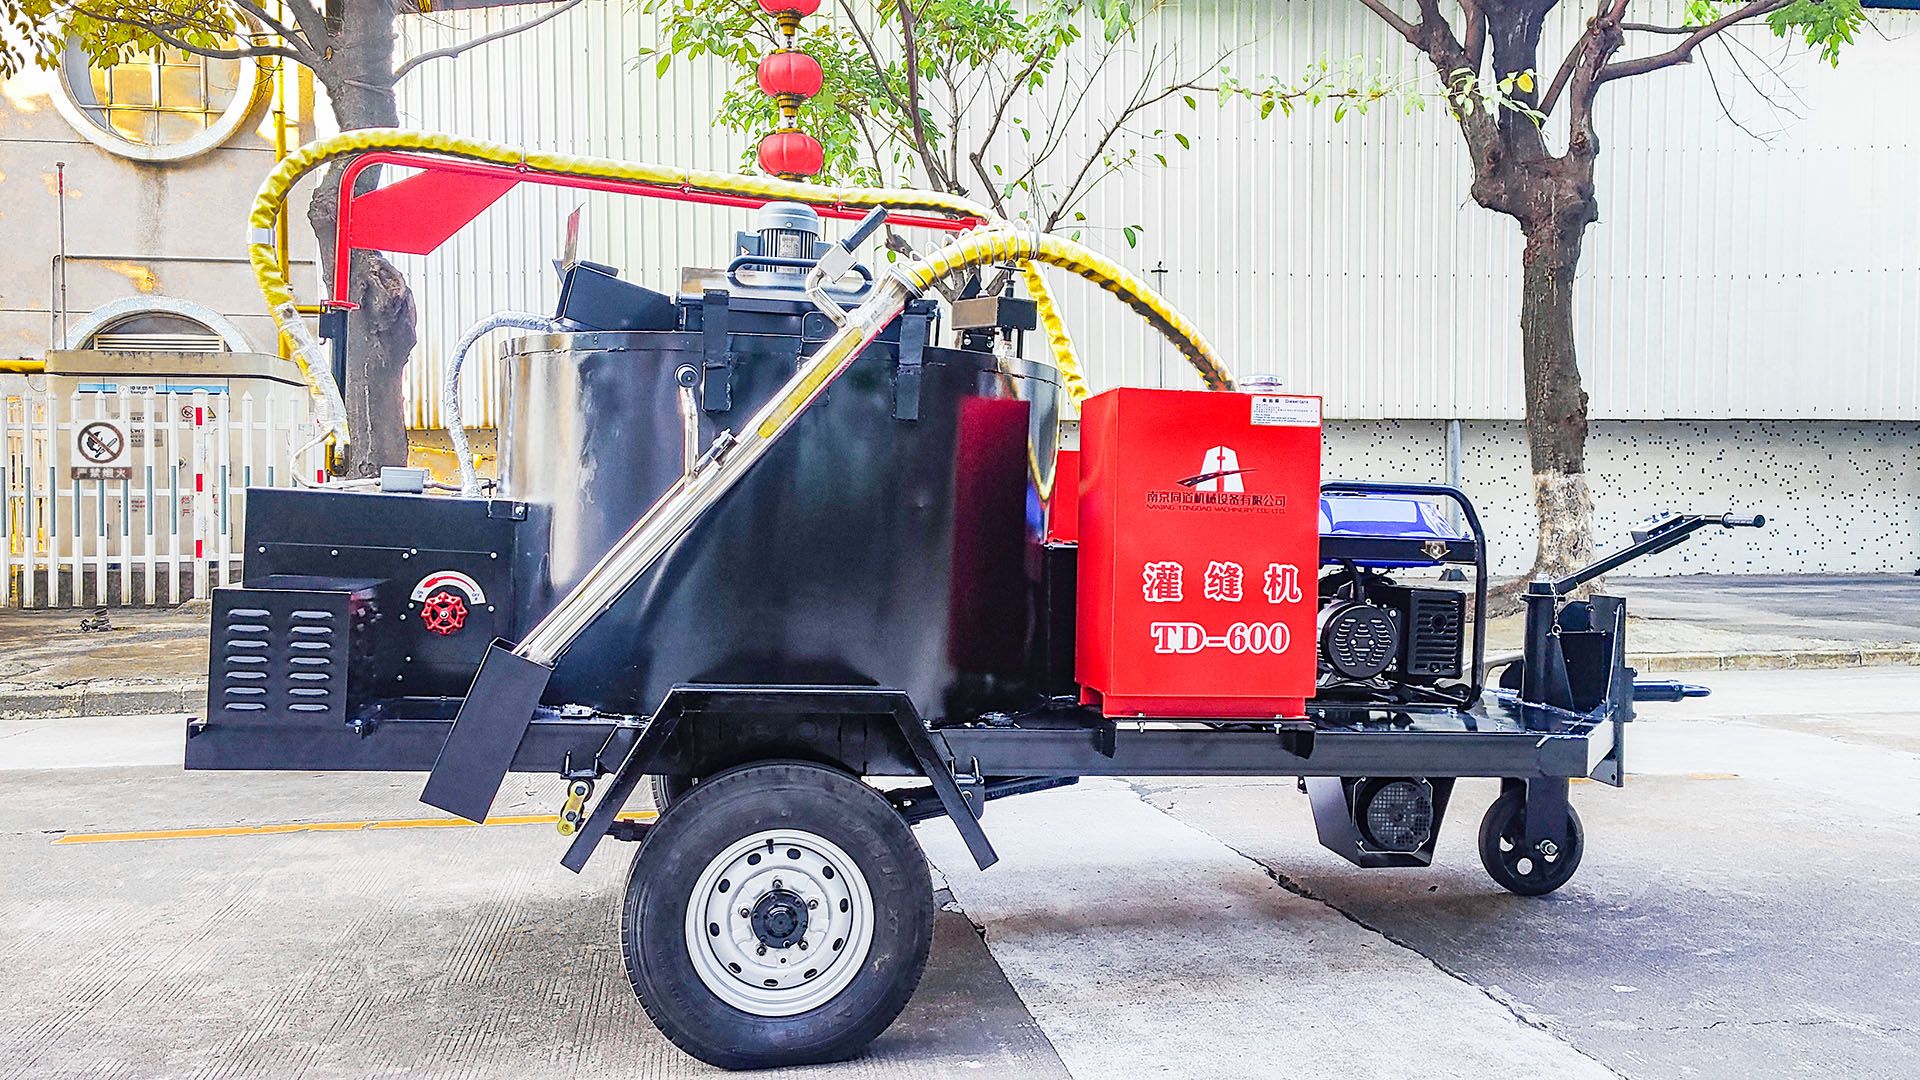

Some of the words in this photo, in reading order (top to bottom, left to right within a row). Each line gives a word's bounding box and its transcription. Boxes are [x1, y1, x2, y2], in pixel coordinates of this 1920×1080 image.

[73, 467, 127, 479] 严禁烟火
[1147, 491, 1286, 507] 南京同道机械设备有限公司
[1142, 561, 1302, 604] 灌缝机
[1151, 622, 1290, 654] TD-600
